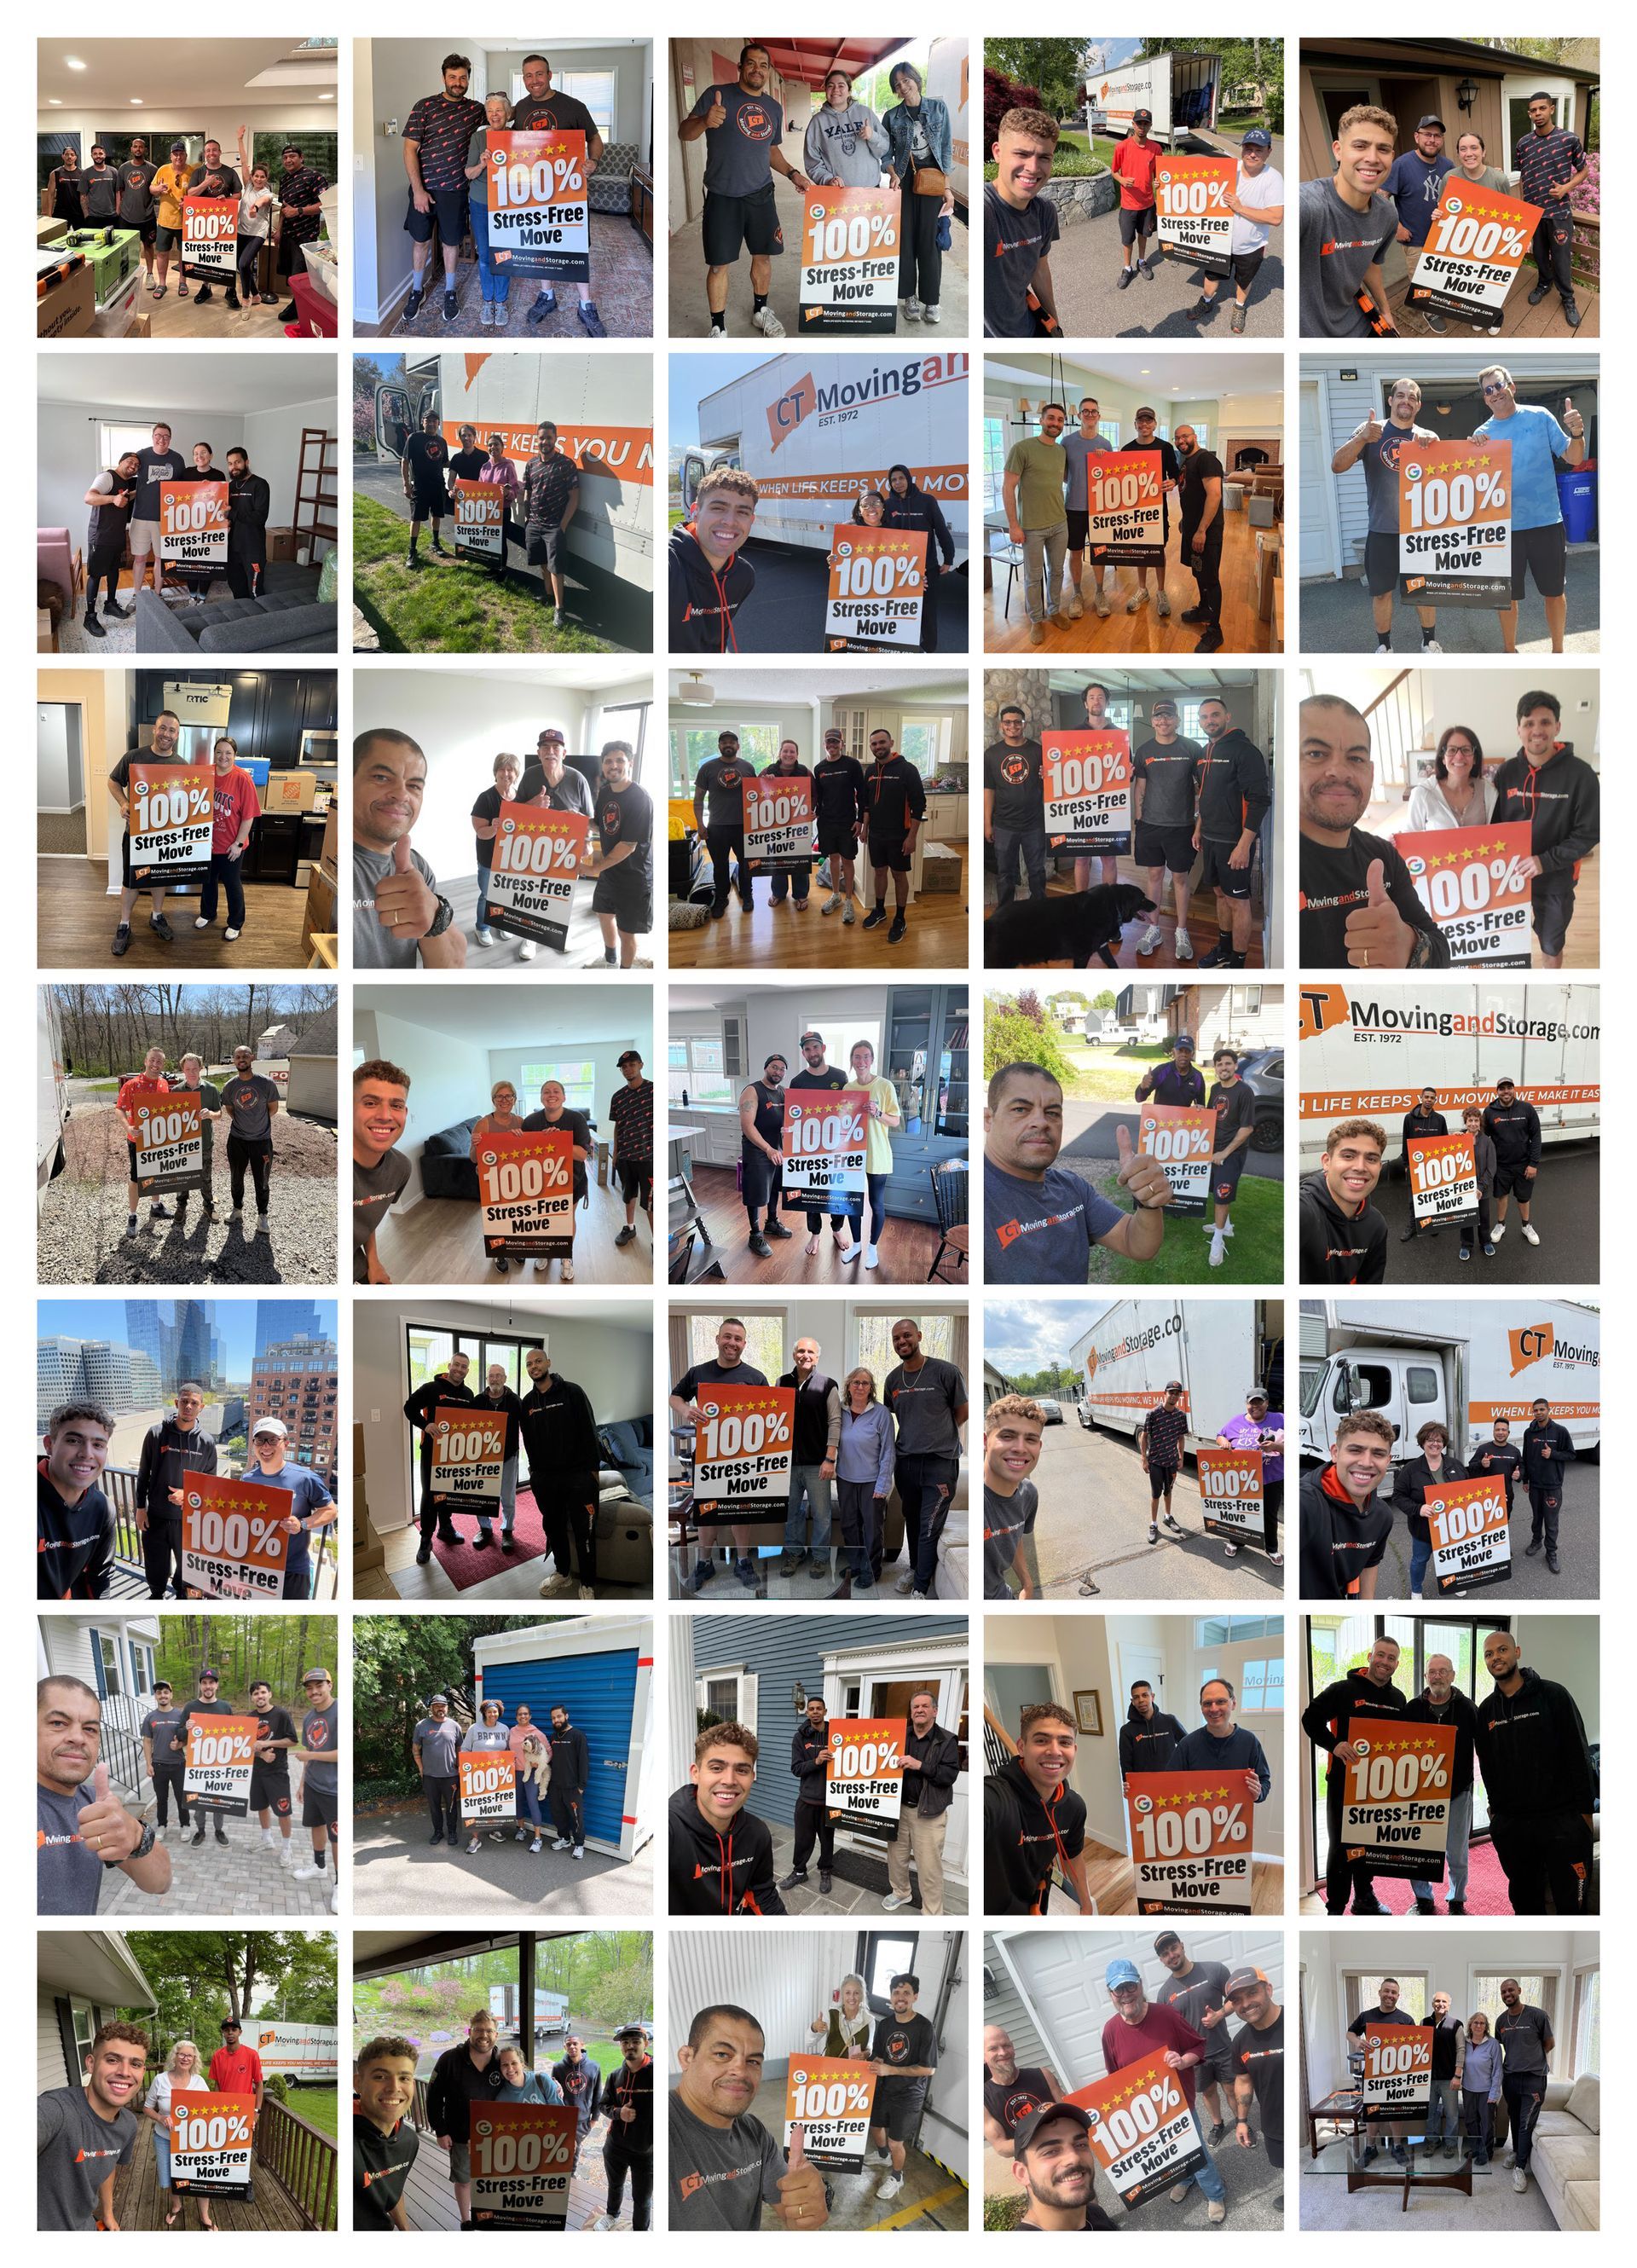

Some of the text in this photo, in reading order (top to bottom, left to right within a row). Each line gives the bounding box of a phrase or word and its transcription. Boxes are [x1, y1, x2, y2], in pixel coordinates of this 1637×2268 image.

[824, 120, 865, 138] YALE
[491, 157, 581, 206] 100%
[1160, 181, 1229, 214] 100%
[493, 206, 583, 229] Stress-Free
[1161, 217, 1229, 232] Stress-Free
[184, 215, 234, 240] 100%
[1435, 215, 1527, 258] 100%
[184, 242, 234, 252] Stress-Free
[520, 229, 562, 246] Move
[808, 215, 895, 262] 100%
[1179, 232, 1211, 245] Move
[198, 253, 222, 263] Move
[512, 255, 585, 265] MovingandStorage.com
[807, 260, 895, 286] Stress-Free
[1423, 256, 1511, 282] Stress-Free
[832, 283, 874, 301] Move
[1443, 276, 1485, 295] Move
[824, 310, 893, 318] MovingandStorage.com
[1431, 294, 1494, 316] MovingandStorage.com
[777, 392, 804, 426] CT
[818, 410, 859, 427] EST. 1972
[573, 437, 629, 466] YOU
[759, 478, 868, 494] WHEN LIFE KEEPS
[1092, 472, 1158, 512] 100%
[1405, 471, 1505, 528] 100%
[165, 500, 224, 532] 100%
[457, 500, 500, 524] 100%
[1093, 509, 1160, 529] Stress-Free
[165, 531, 225, 547] Stress-Free
[457, 526, 500, 536] Stress-Free
[1113, 527, 1144, 541] Move
[1405, 526, 1506, 553] Stress-Free
[469, 536, 489, 547] Move
[182, 547, 210, 558] Move
[1435, 551, 1482, 570] Move
[836, 556, 920, 595] 100%
[1426, 581, 1506, 591] MovingandStorage.com
[832, 600, 918, 616] Stress-Free
[857, 618, 897, 635] Move
[1048, 752, 1125, 797] 100%
[135, 788, 210, 831] 100%
[747, 794, 807, 830] 100%
[1050, 793, 1126, 818] Stress-Free
[1073, 813, 1109, 830] Move
[135, 825, 210, 850] Stress-Free
[748, 825, 808, 846] Stress-Free
[159, 846, 193, 862] Move
[499, 835, 577, 873] 100%
[766, 841, 795, 854] Move
[151, 865, 208, 874] MovingandStorage.com
[493, 874, 571, 896] Stress-Free
[512, 893, 549, 911] Move
[504, 911, 563, 934] MovingandStorage.com
[1450, 932, 1500, 957] Move
[1354, 1033, 1402, 1043] EST. 1972
[1313, 1090, 1599, 1111] LIFE KEEPS WE MAKE IT EAS
[139, 1110, 200, 1148] 100%
[788, 1114, 864, 1154] 100%
[141, 1141, 200, 1164] Stress-Free
[1143, 1129, 1210, 1160] 100%
[159, 1157, 187, 1172] Move
[787, 1154, 863, 1172] Stress-Free
[1414, 1150, 1472, 1189] 100%
[483, 1156, 569, 1201] 100%
[809, 1172, 844, 1186] Move
[1417, 1182, 1474, 1206] Stress-Free
[487, 1198, 569, 1221] Stress-Free
[1436, 1196, 1463, 1212] Move
[512, 1217, 550, 1234] Move
[1520, 1330, 1599, 1367] CT Moving
[1142, 1397, 1152, 1405] WE
[1491, 1405, 1590, 1417] WHEN KEEPS YOU
[702, 1412, 790, 1459] 100%
[437, 1431, 501, 1462] 100%
[435, 1464, 500, 1478] Stress-Free
[701, 1456, 788, 1481] Stress-Free
[454, 1478, 483, 1491] Move
[727, 1477, 767, 1496] Move
[1202, 1470, 1258, 1496] 100%
[1204, 1499, 1260, 1512] Stress-Free
[1219, 1510, 1246, 1523] Move
[1433, 1496, 1504, 1546] 100%
[187, 1511, 281, 1558] 100%
[1437, 1530, 1506, 1563] Stress-Free
[1461, 1550, 1492, 1569] Move
[187, 1553, 279, 1588] Stress-Free
[1456, 1565, 1508, 1580] MovingandStorage.com
[210, 1577, 252, 1600] Move
[477, 1732, 506, 1740] BROWN
[191, 1735, 251, 1765] 100%
[832, 1742, 899, 1777] 100%
[188, 1768, 249, 1779] Stress-Free
[463, 1765, 513, 1795] 100%
[1351, 1753, 1447, 1801] 100%
[205, 1781, 233, 1791] Move
[830, 1780, 898, 1794] Stress-Free
[464, 1791, 513, 1808] Stress-Free
[847, 1796, 880, 1808] Move
[480, 1804, 502, 1815] Move
[1349, 1803, 1444, 1825] Stress-Free
[842, 1813, 894, 1828] MovingandStorage.com
[1137, 1803, 1247, 1859] 100%
[1376, 1825, 1420, 1843] Move
[1366, 1851, 1441, 1864] MovingandStorage.com
[1141, 1859, 1246, 1882] Stress-Free
[1171, 1881, 1219, 1899] Move
[259, 2034, 271, 2044] CT
[1368, 2043, 1429, 2075] 100%
[1368, 2073, 1428, 2092] Stress-Free
[792, 2083, 868, 2118] 100%
[1386, 2087, 1414, 2101] Move
[1092, 2075, 1180, 2159] 100%
[174, 2116, 249, 2150] 100%
[812, 2136, 846, 2148] Move
[476, 2132, 569, 2174] 100%
[1111, 2115, 1189, 2178] Stress-Free
[175, 2151, 247, 2166] Stress-Free
[1141, 2143, 1178, 2176] Move
[197, 2167, 229, 2178] Move
[1142, 2152, 1201, 2190] MovingandStorage.com
[477, 2177, 566, 2194] Stress-Free
[685, 2176, 701, 2188] CT
[502, 2194, 543, 2208] Move
[494, 2214, 562, 2225] MovingandStorage.com
